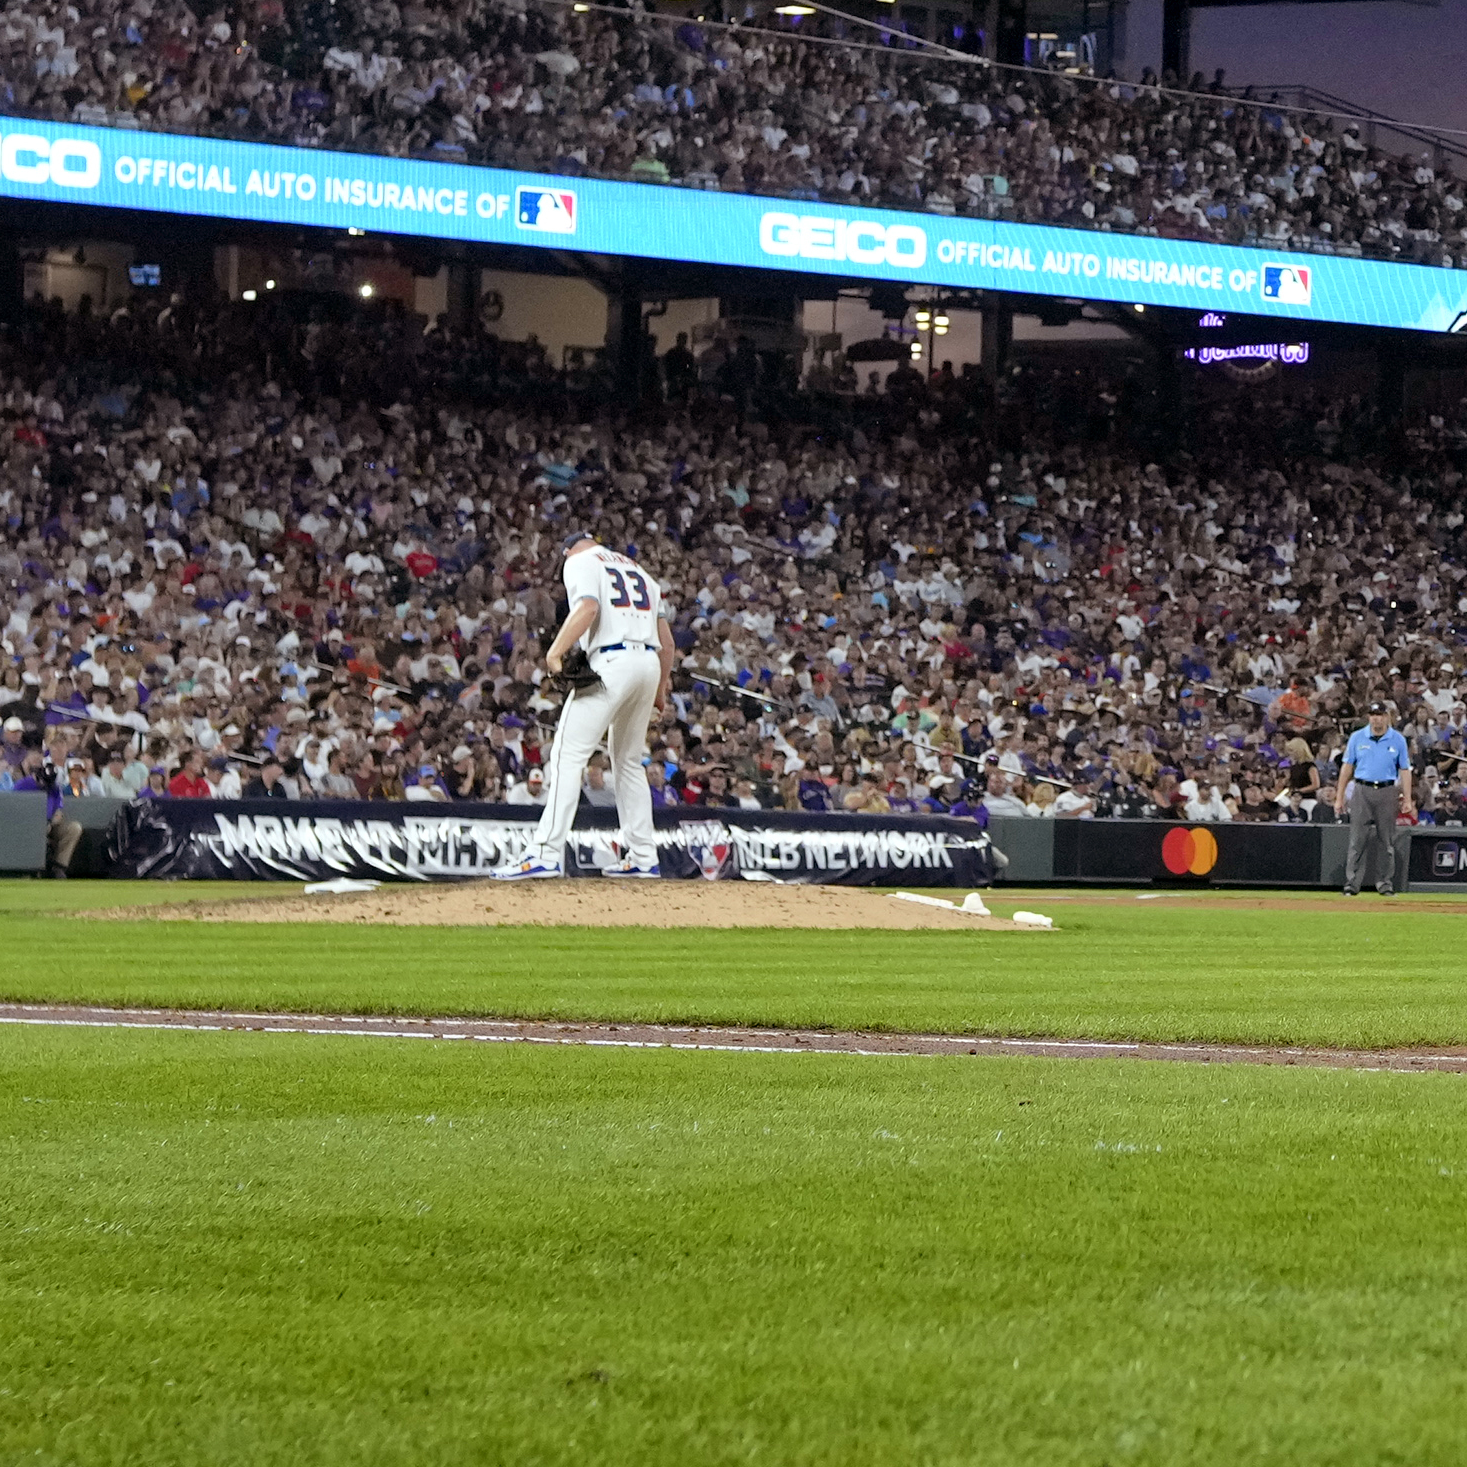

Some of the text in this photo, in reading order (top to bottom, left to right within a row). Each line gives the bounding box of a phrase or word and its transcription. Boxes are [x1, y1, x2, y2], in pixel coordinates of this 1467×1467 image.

[114, 155, 237, 195] OFFICIAL
[245, 168, 317, 202] AUTO
[324, 180, 468, 218] INSURANCE
[474, 193, 510, 221] OF
[758, 210, 1259, 293] GEICO OFFICIAL AUTO INSURANCE OF
[605, 566, 651, 611] 33
[737, 831, 799, 870] MLB
[803, 831, 954, 870] NETWORK
